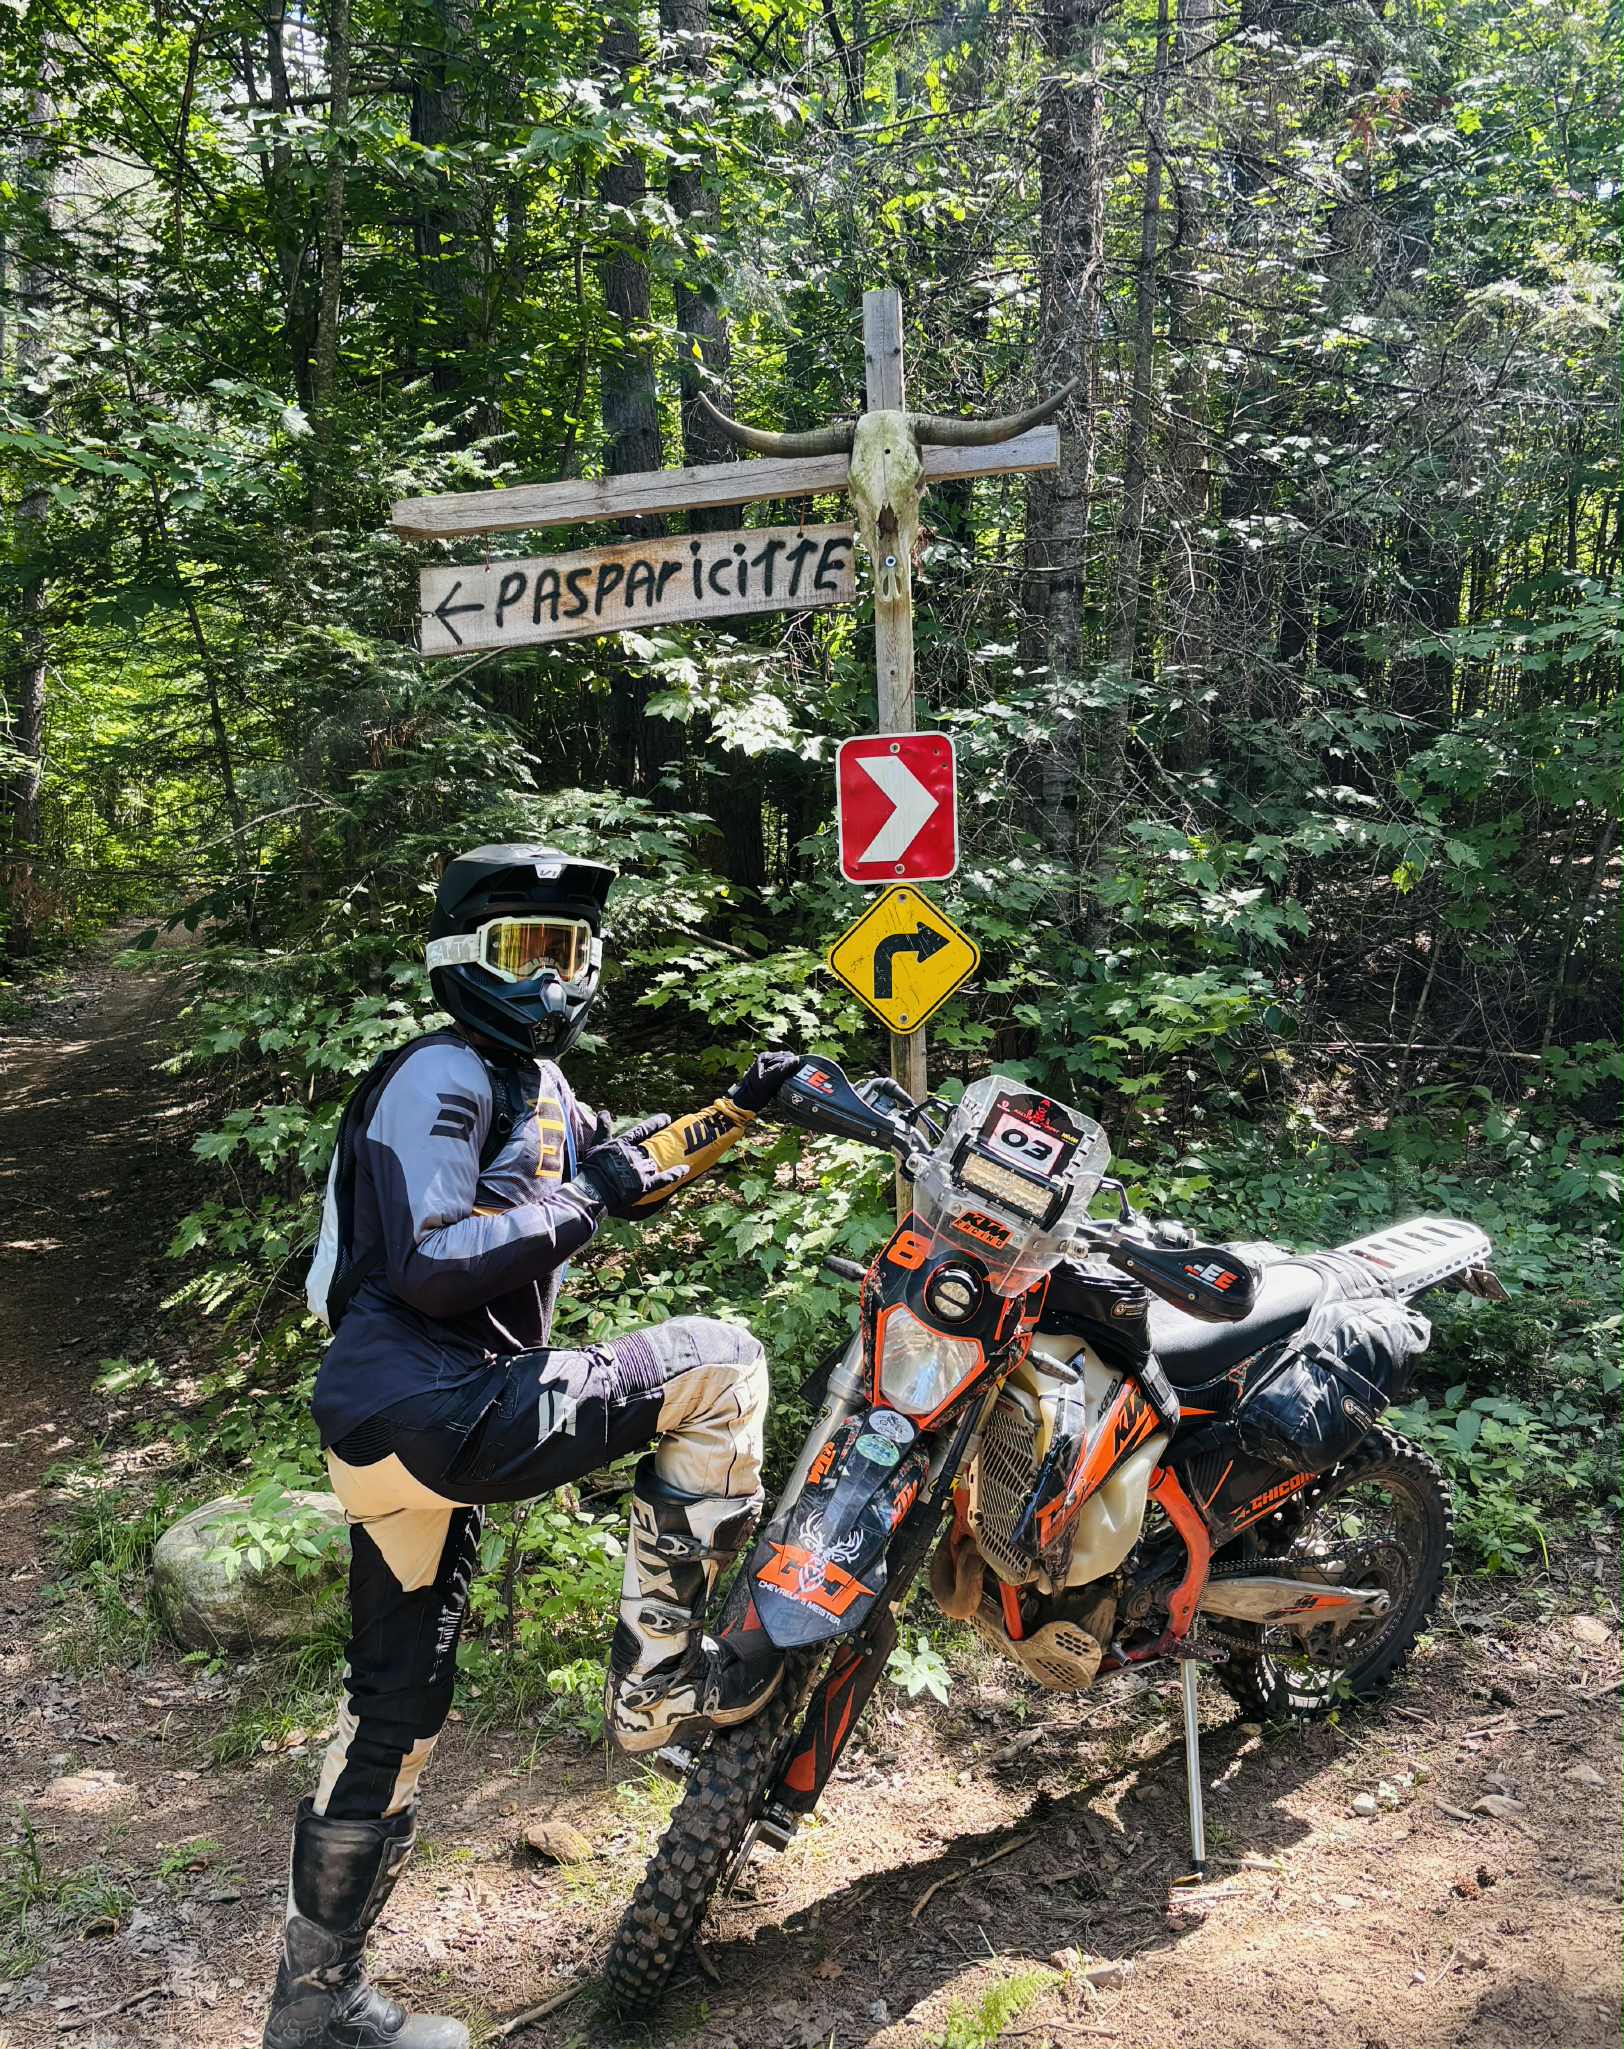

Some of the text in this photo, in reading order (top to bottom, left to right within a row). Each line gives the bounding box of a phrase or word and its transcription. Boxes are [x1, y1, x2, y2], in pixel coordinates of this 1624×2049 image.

[1001, 1129, 1053, 1161] 03
[954, 1219, 1003, 1248] RACING
[960, 1211, 1012, 1242] KTM
